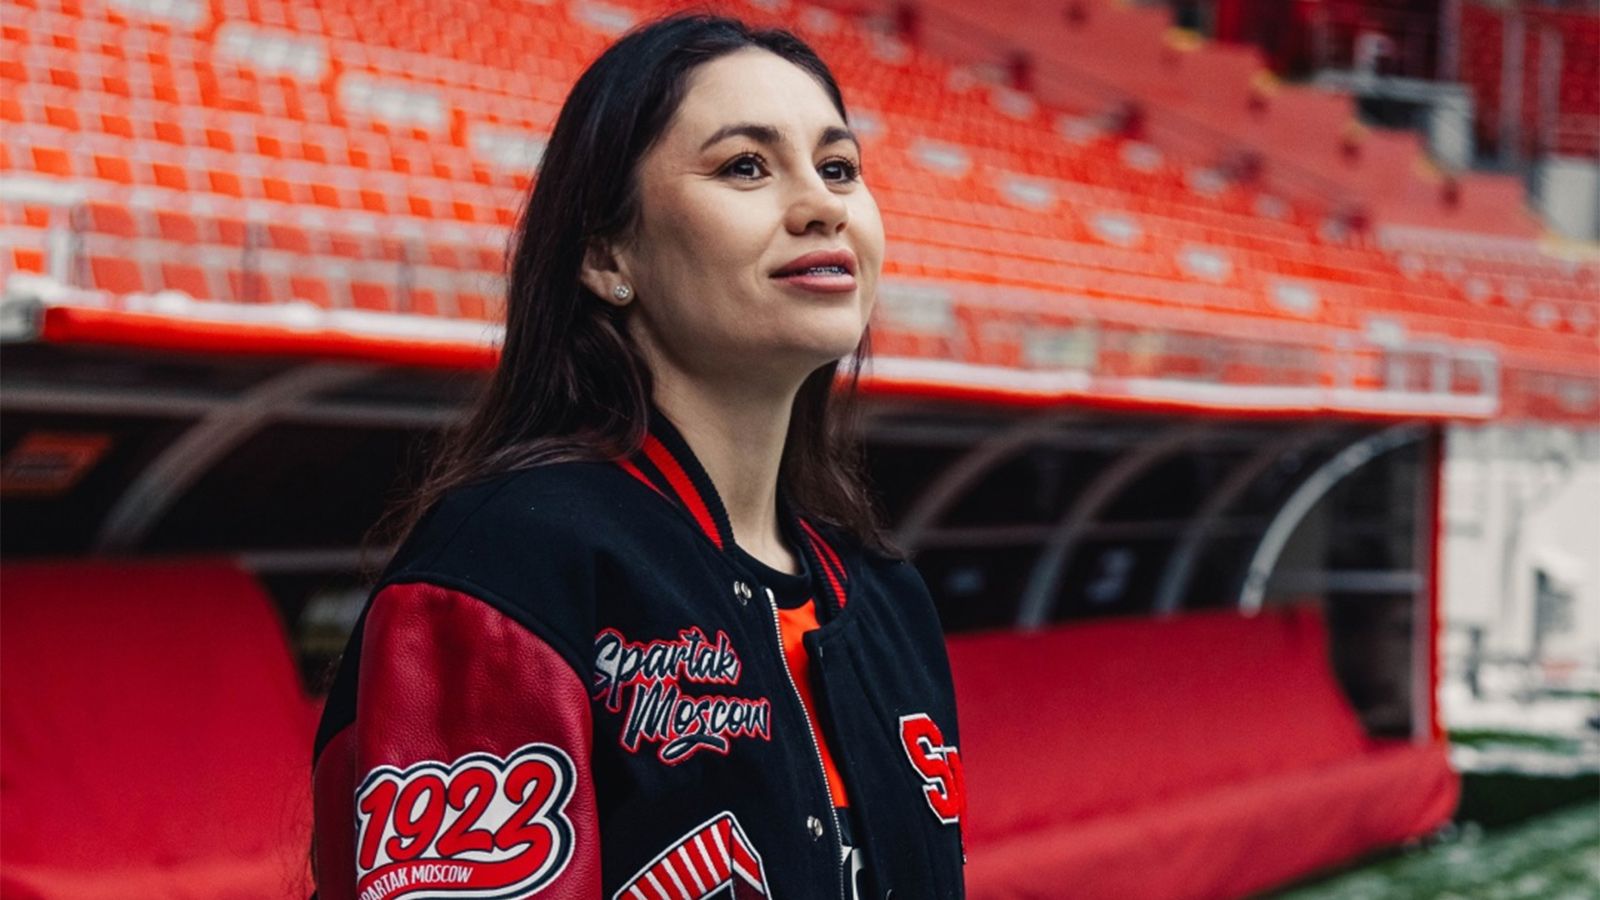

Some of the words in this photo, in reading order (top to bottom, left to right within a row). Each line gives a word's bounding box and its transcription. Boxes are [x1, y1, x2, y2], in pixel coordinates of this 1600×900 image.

[594, 627, 741, 711] Spartak
[621, 680, 770, 765] Moscow
[359, 758, 557, 869] 1922
[359, 867, 409, 900] PARTAK
[411, 864, 473, 884] MOSCOW
